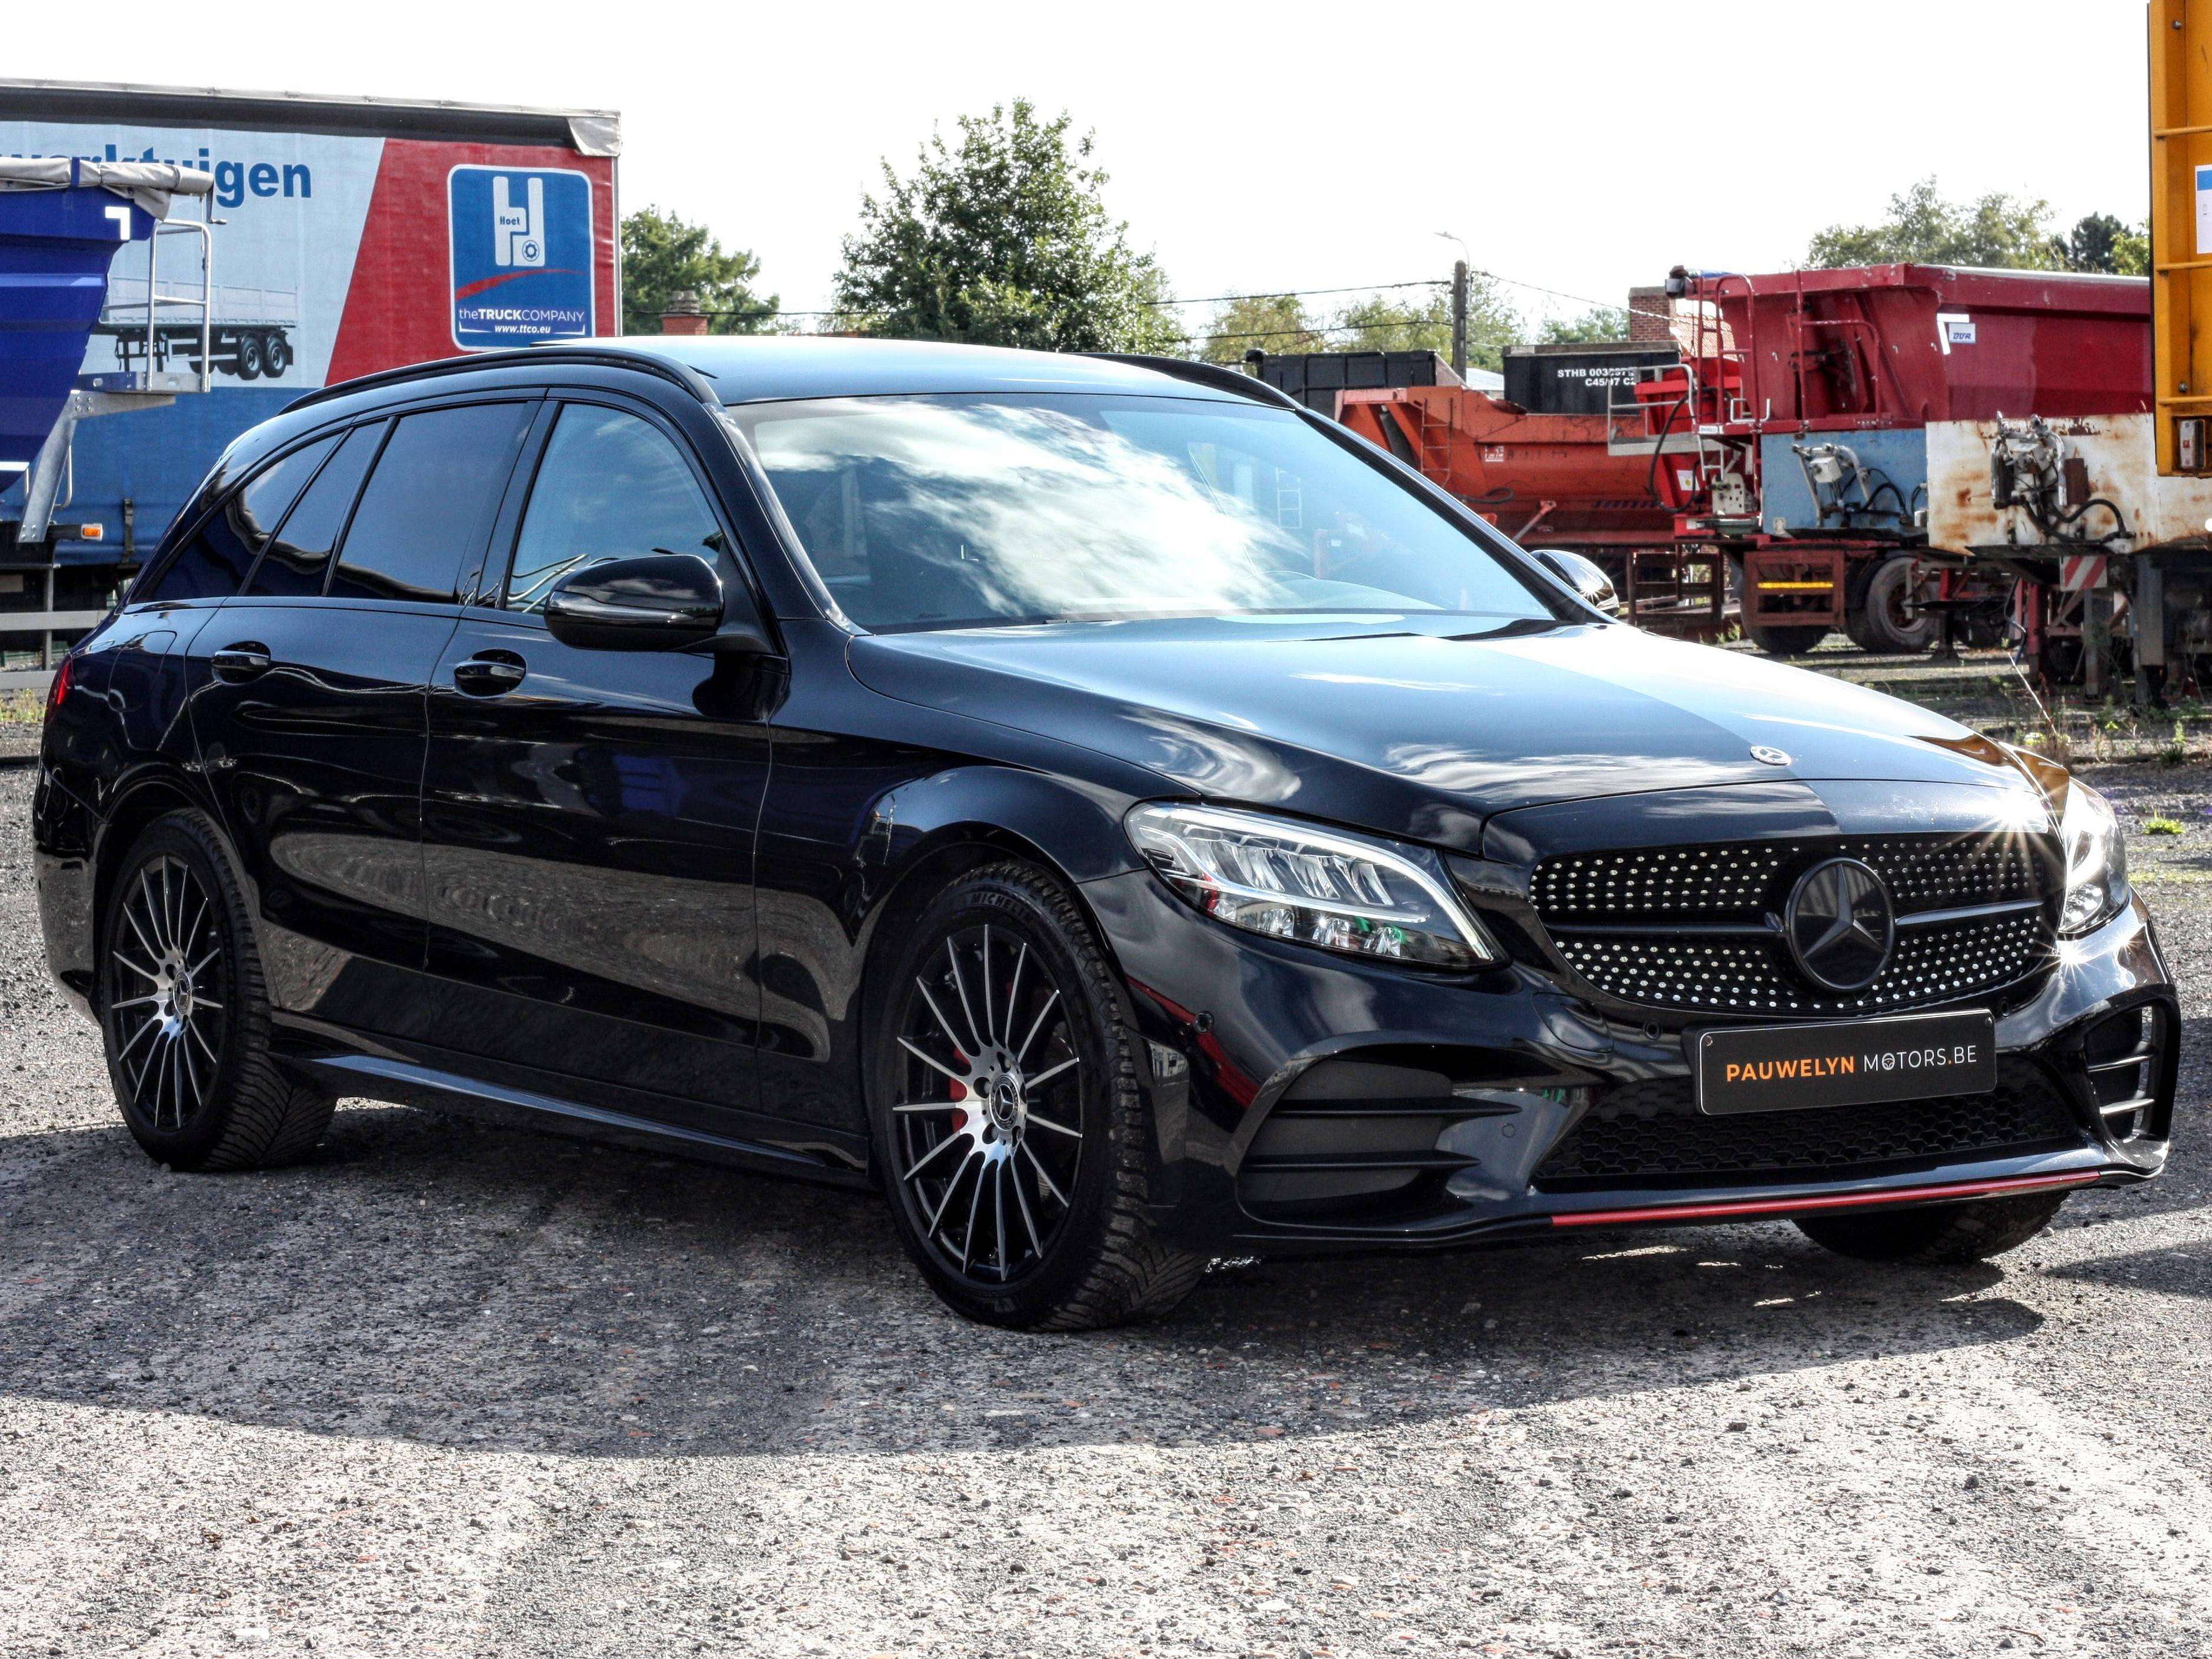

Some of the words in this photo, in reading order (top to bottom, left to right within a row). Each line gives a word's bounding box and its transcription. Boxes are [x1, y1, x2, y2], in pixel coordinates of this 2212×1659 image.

[459, 308, 585, 321] theTRUCKCOMPANY
[495, 325, 551, 334] www.ttco.eu
[1557, 369, 1586, 378] STHB
[1726, 1056, 1854, 1082] PAUWELYN
[1864, 1045, 1977, 1072] MOTORS.BE
